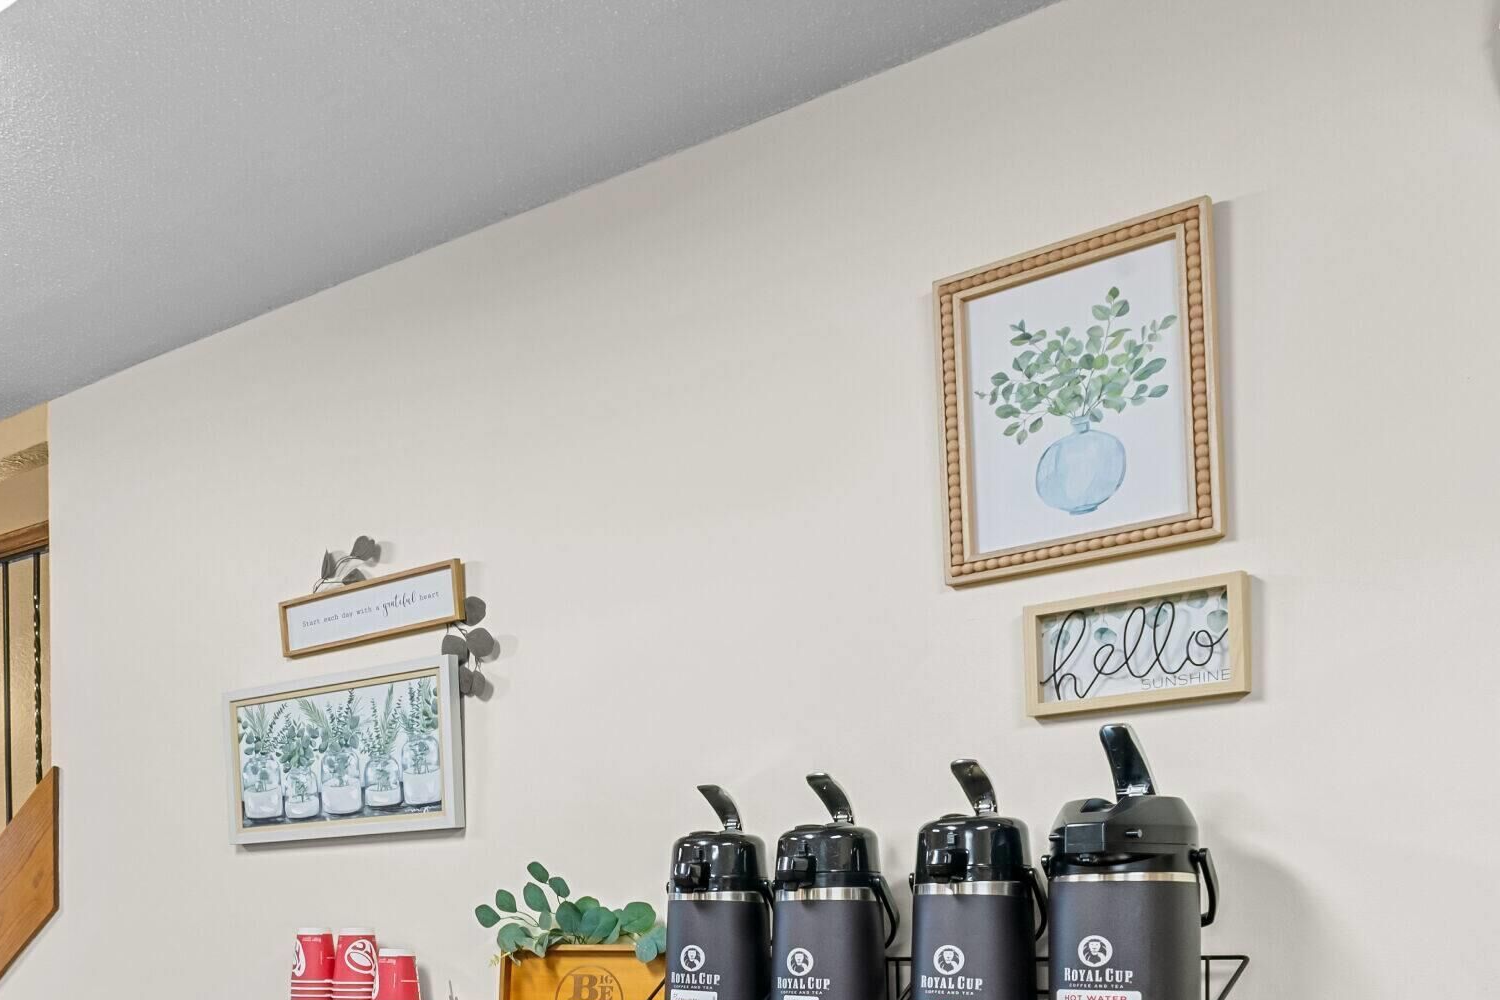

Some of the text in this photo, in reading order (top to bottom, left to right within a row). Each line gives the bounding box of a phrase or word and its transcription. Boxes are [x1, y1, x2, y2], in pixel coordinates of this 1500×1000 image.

[302, 619, 320, 628] Start
[323, 614, 339, 623] each
[341, 611, 353, 620] day
[356, 606, 372, 615] with
[382, 590, 416, 617] grateful
[419, 591, 439, 601] heart
[1040, 600, 1229, 700] hello
[1141, 668, 1231, 690] SUNSHINE
[671, 971, 721, 986] ROYAL CUP
[777, 976, 831, 990] ROYAL CUP
[921, 975, 983, 990] ROYAL CUP
[1064, 967, 1133, 983] ROYAL CUP
